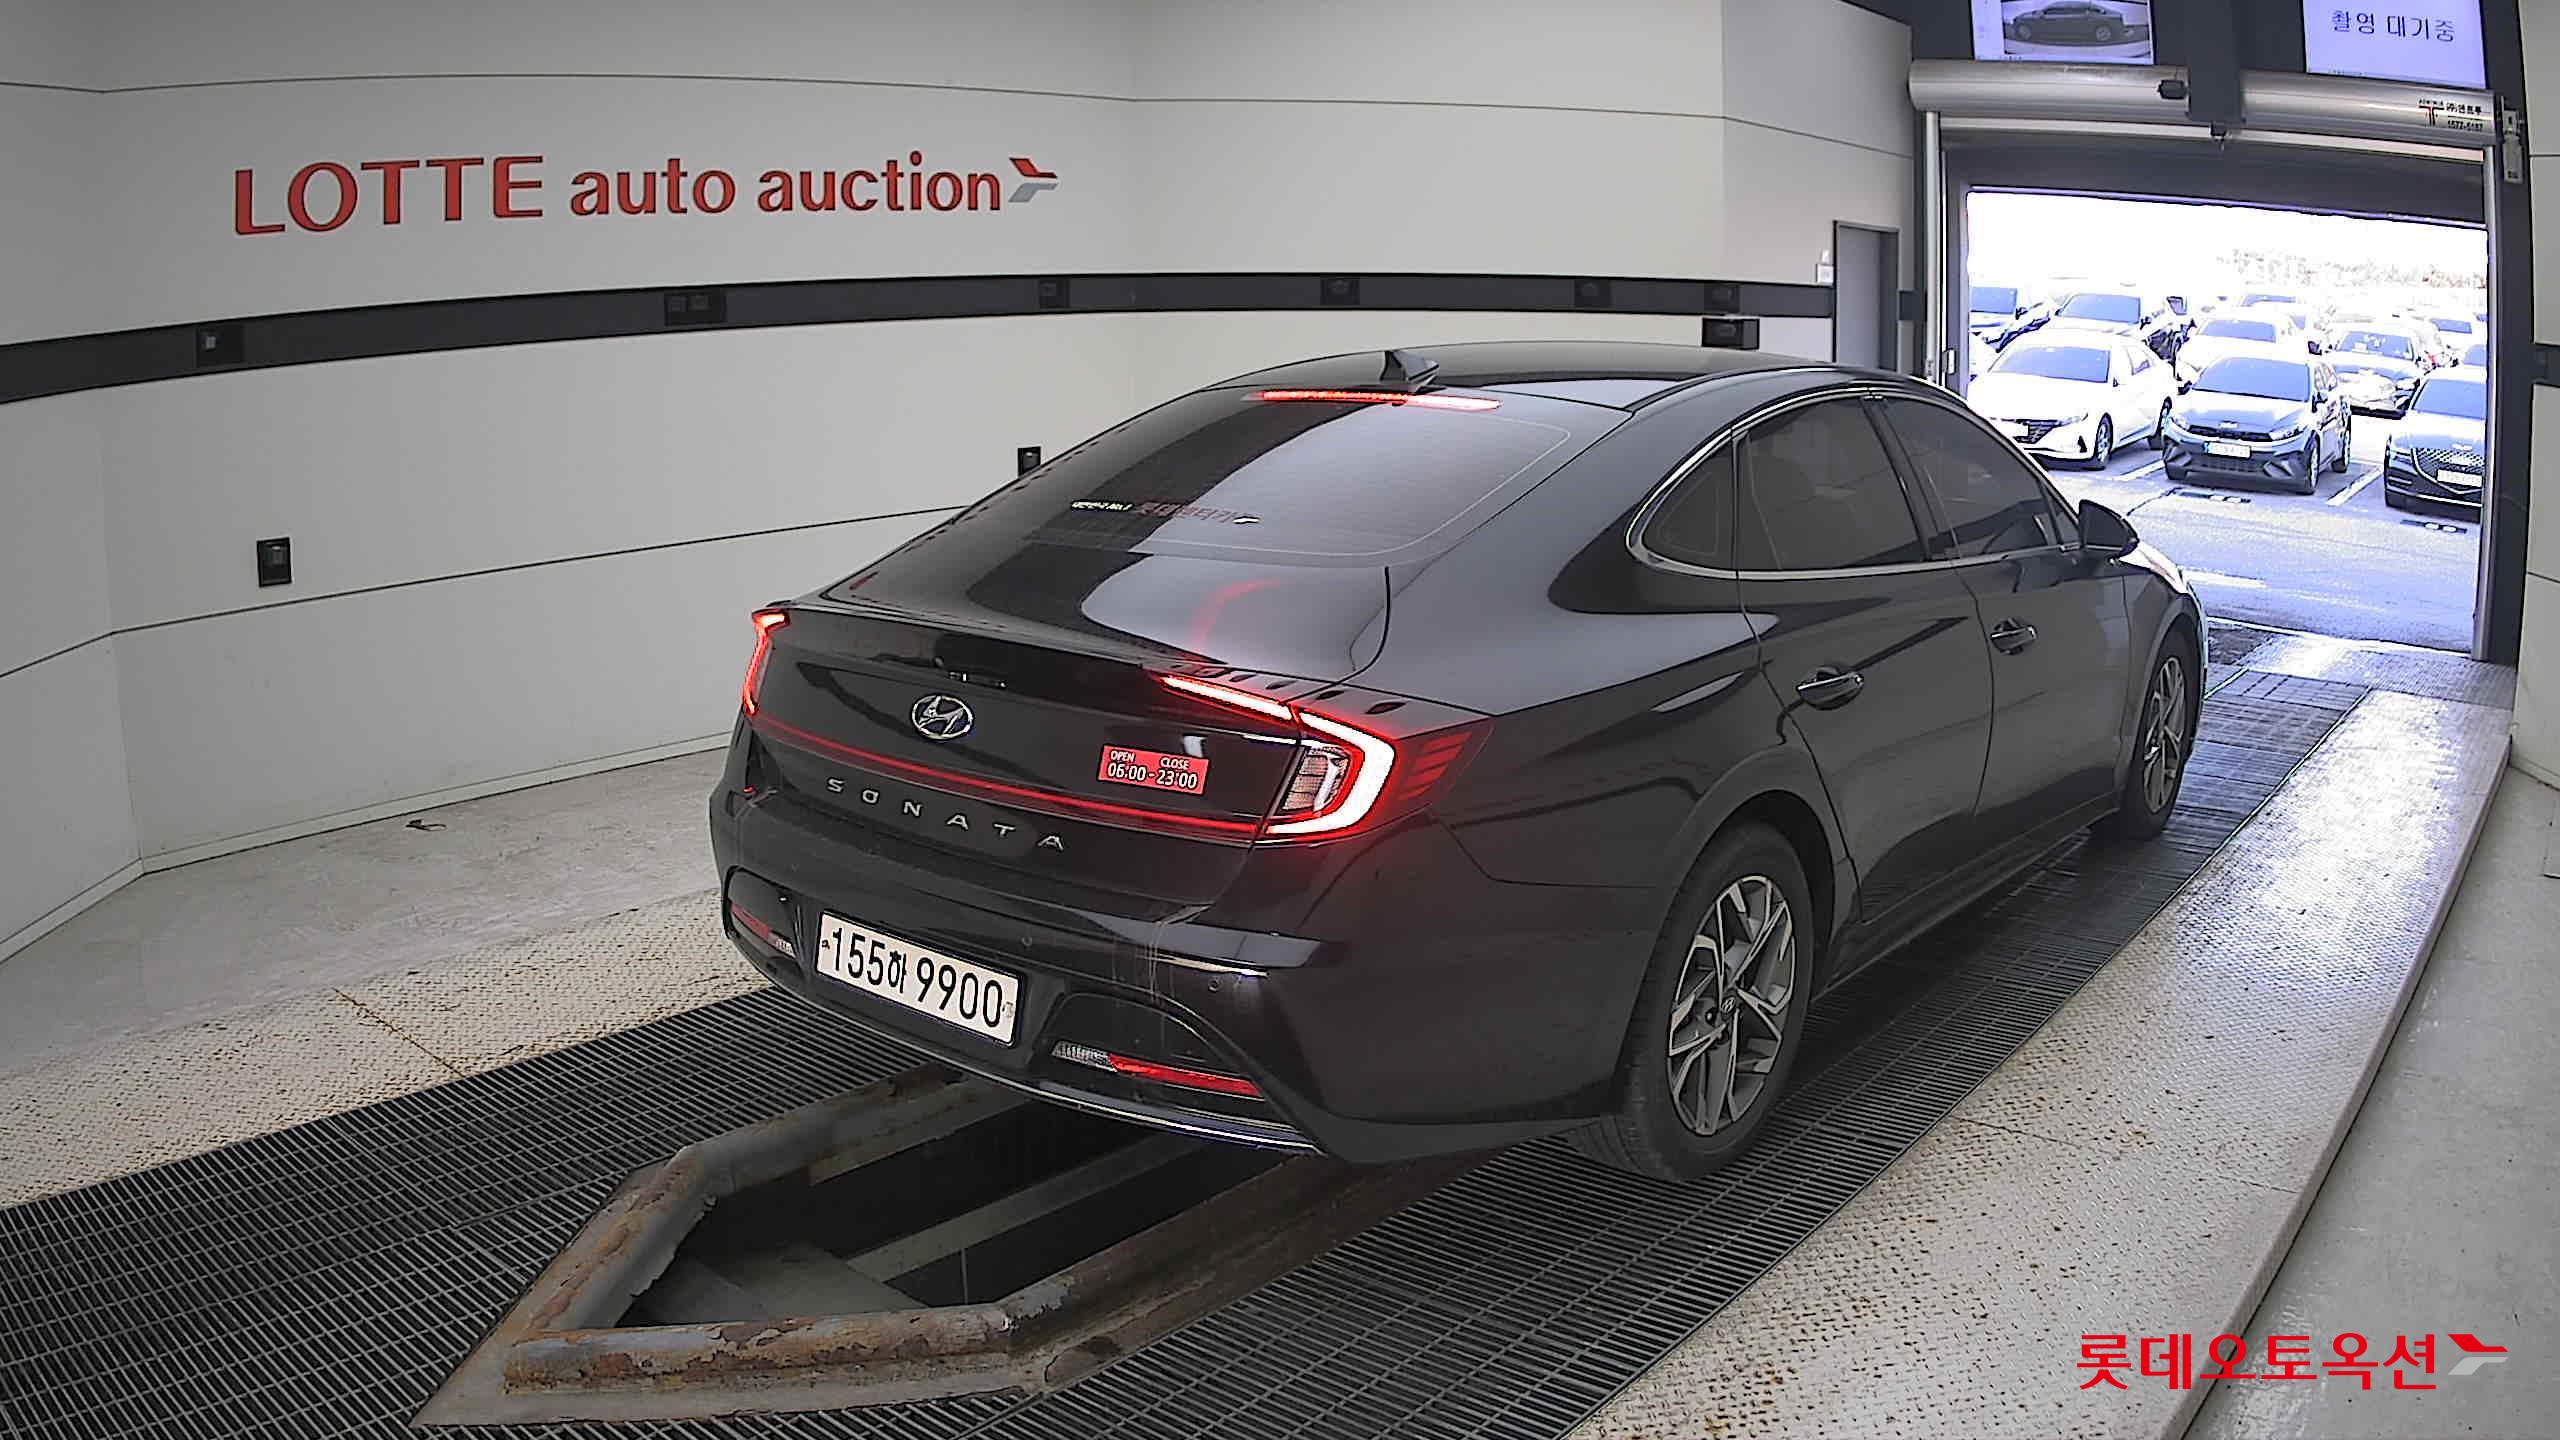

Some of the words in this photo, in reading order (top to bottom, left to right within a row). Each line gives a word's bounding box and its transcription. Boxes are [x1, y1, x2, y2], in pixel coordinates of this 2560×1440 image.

[2332, 9, 2375, 35] 촬영
[2387, 15, 2456, 43] 대기중
[234, 155, 544, 236] LOTTE
[569, 157, 737, 218] auto
[756, 150, 1001, 214] auction
[1110, 751, 1136, 763] OPEN
[1160, 757, 1191, 770] CLOSE
[827, 777, 1064, 851] SONATA
[916, 956, 1003, 1028] 9900
